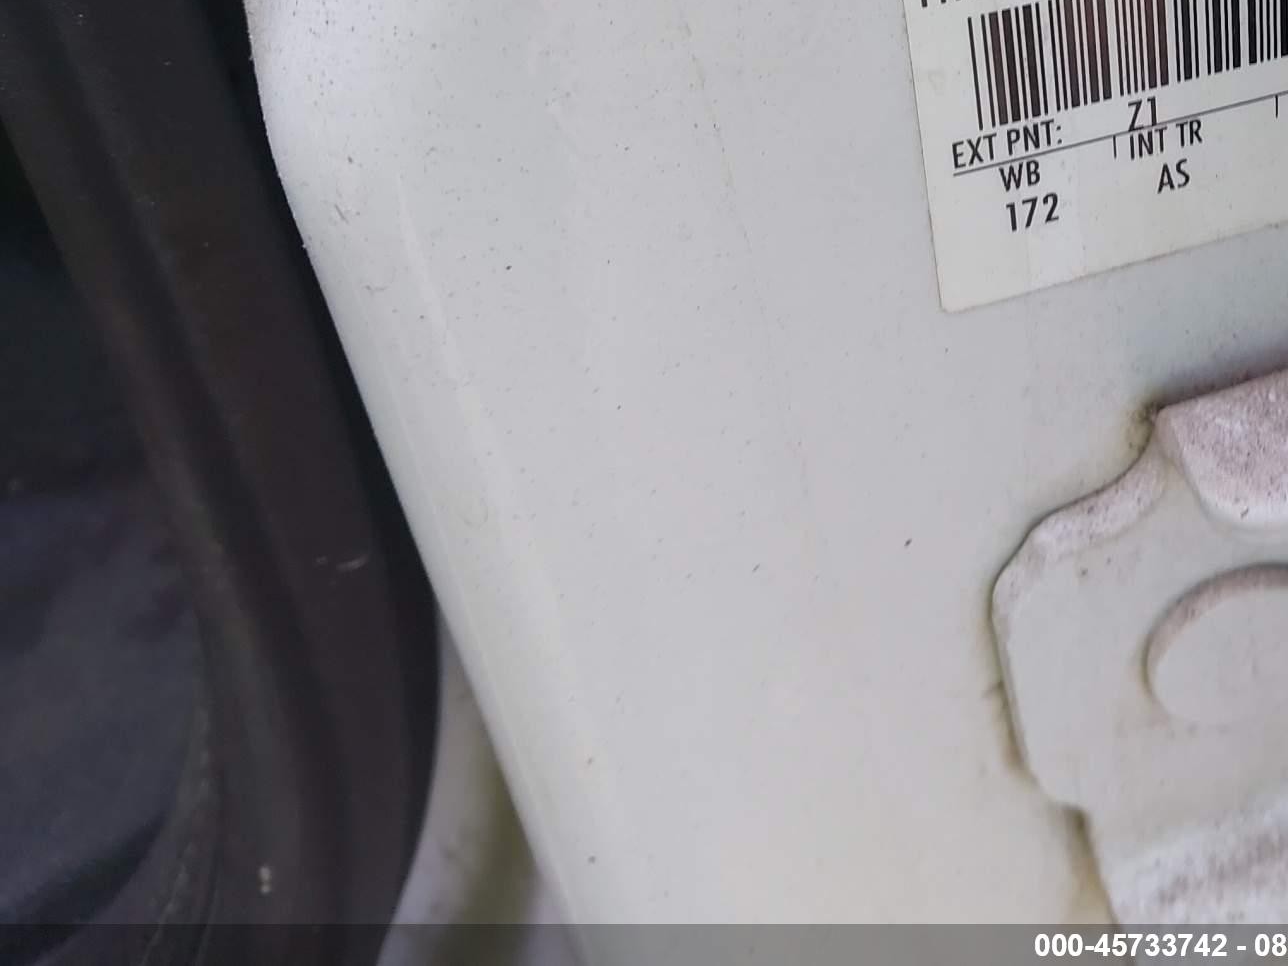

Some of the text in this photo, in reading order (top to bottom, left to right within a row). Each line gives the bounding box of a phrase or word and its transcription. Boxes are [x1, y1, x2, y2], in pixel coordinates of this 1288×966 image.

[952, 132, 997, 170] EXT
[1006, 118, 1063, 157] PNT:
[1129, 120, 1203, 161] INT TR
[999, 160, 1041, 193] WB
[1156, 158, 1191, 194] AS
[1005, 192, 1060, 233] 172
